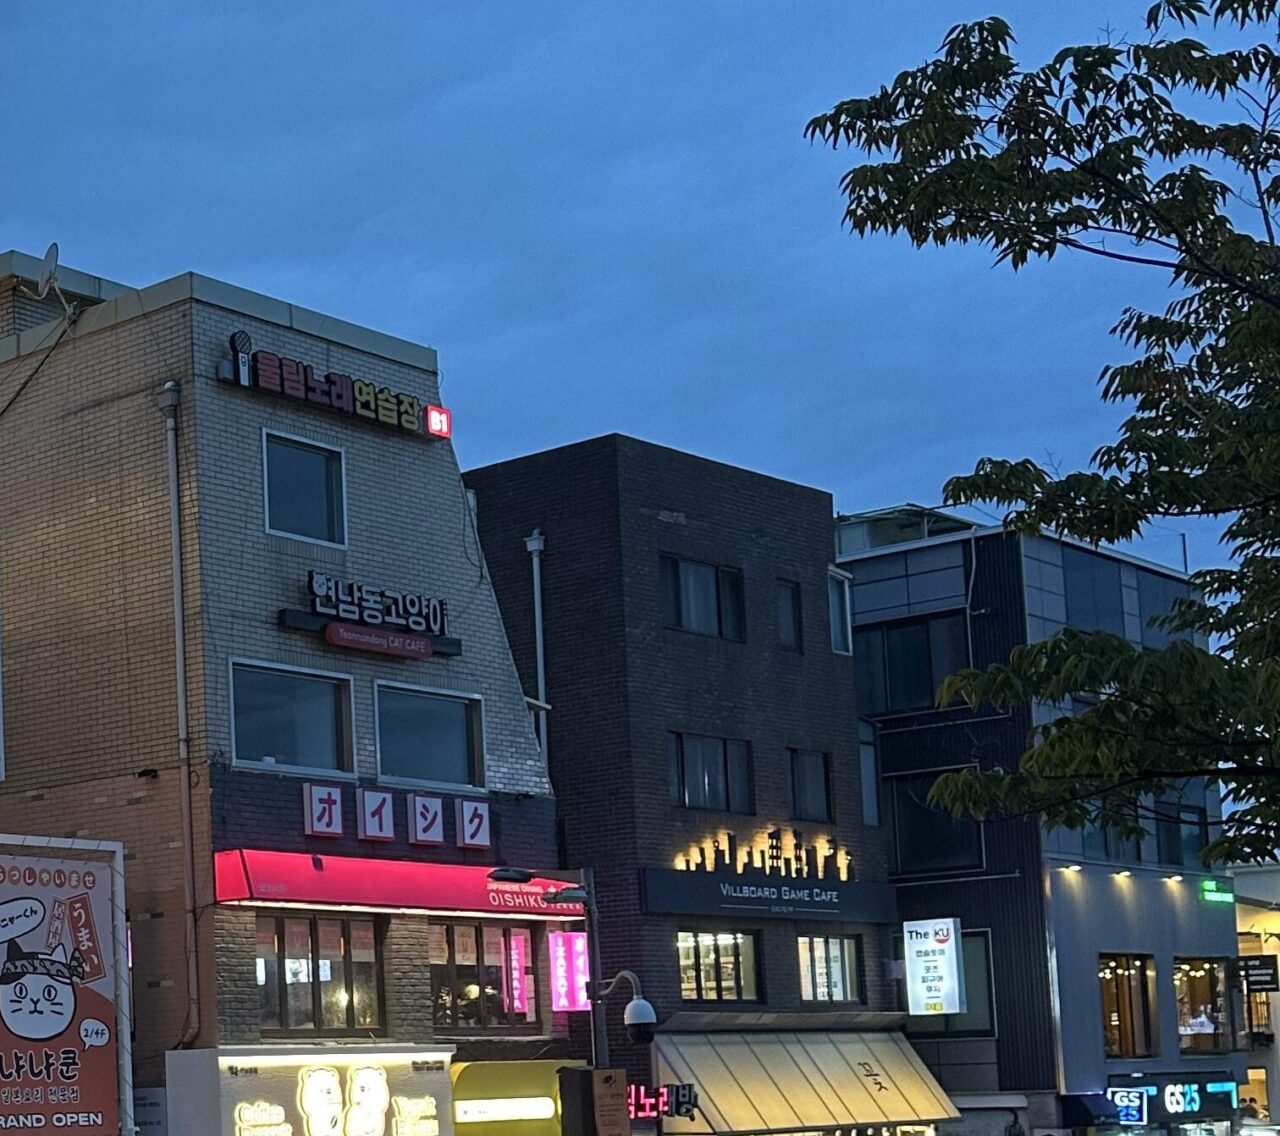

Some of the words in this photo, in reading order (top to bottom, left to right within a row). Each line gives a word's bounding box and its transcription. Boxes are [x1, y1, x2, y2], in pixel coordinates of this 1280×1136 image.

[430, 409, 448, 433] B1
[312, 571, 448, 636] 연남동고양이
[389, 637, 403, 648] CAT
[405, 639, 426, 653] CAFE
[316, 796, 486, 842] オイシク
[781, 887, 811, 901] GAME
[813, 889, 839, 903] CAFE
[907, 930, 930, 941] The
[933, 927, 950, 938] KU
[83, 1027, 107, 1040] 2/4F
[1114, 1091, 1141, 1107] GS
[1164, 1083, 1201, 1114] GS25
[52, 1112, 104, 1127] OPEN
[1118, 1107, 1140, 1121] 25
